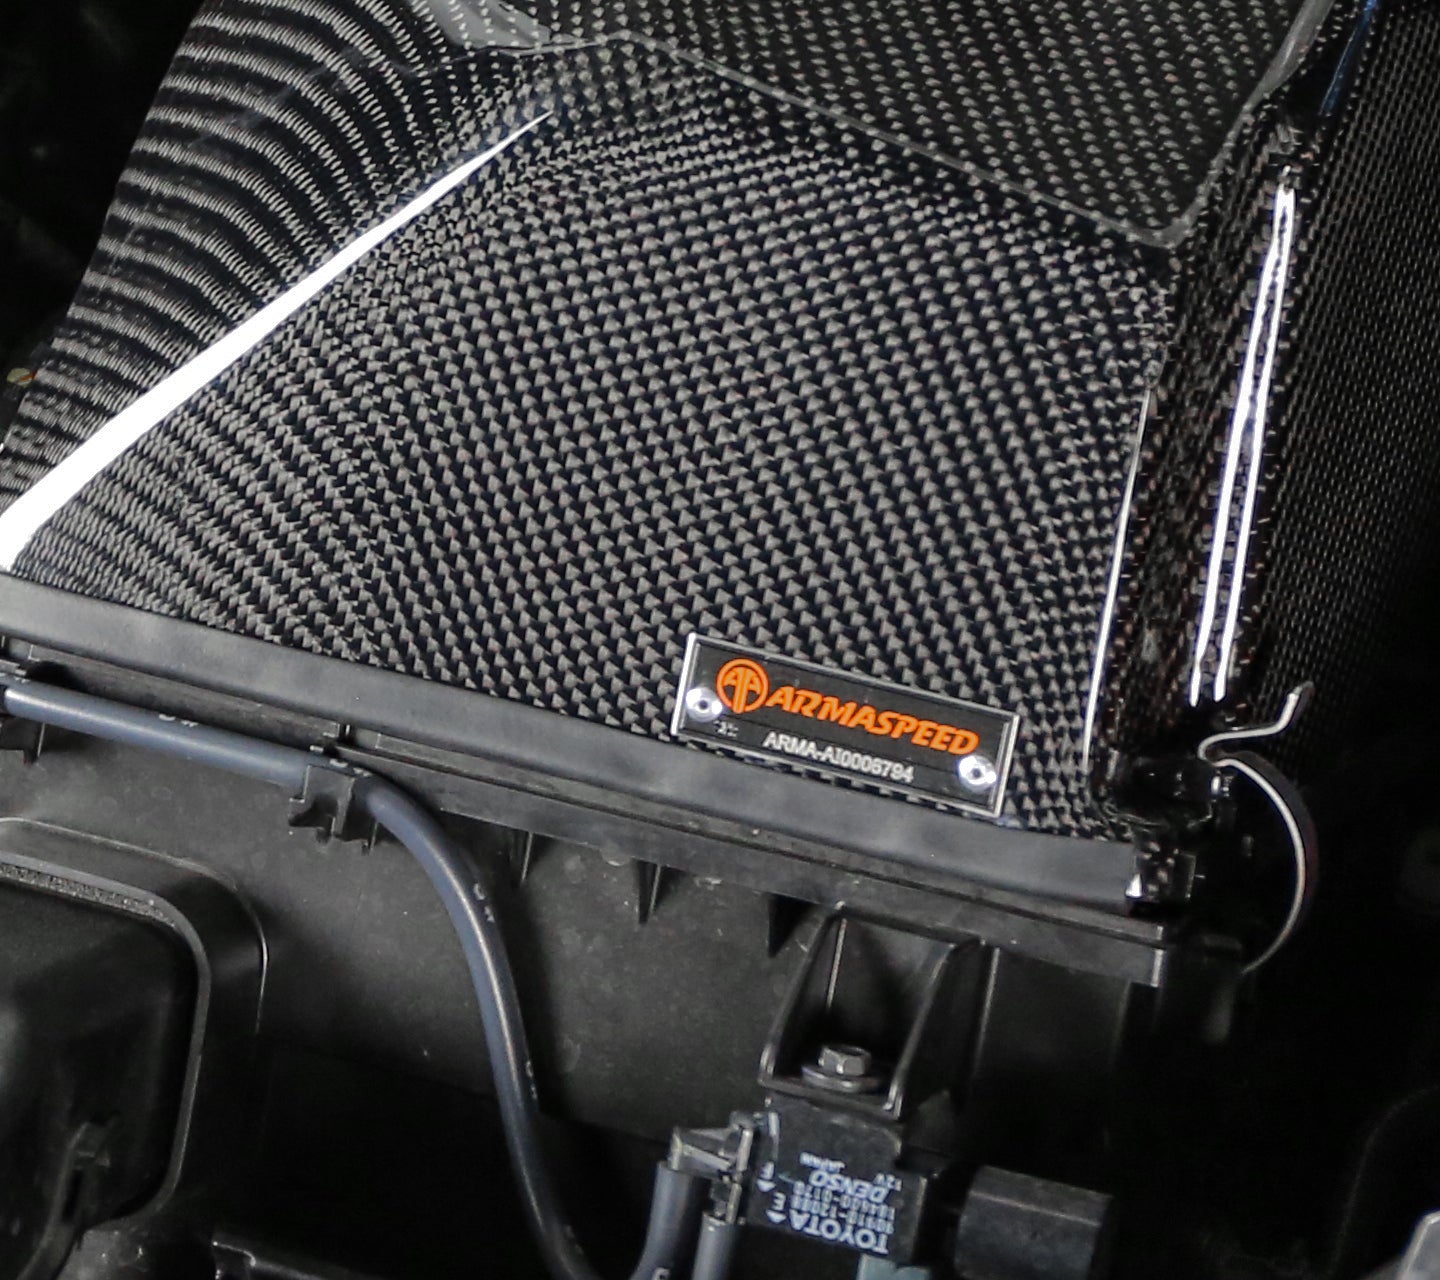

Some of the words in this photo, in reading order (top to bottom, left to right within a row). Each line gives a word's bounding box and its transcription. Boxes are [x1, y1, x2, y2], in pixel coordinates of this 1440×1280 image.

[765, 685, 981, 756] ARMASPEED
[808, 1169, 890, 1204] DENSO
[872, 1172, 903, 1192] 12V
[788, 1208, 889, 1255] TOYOTA
